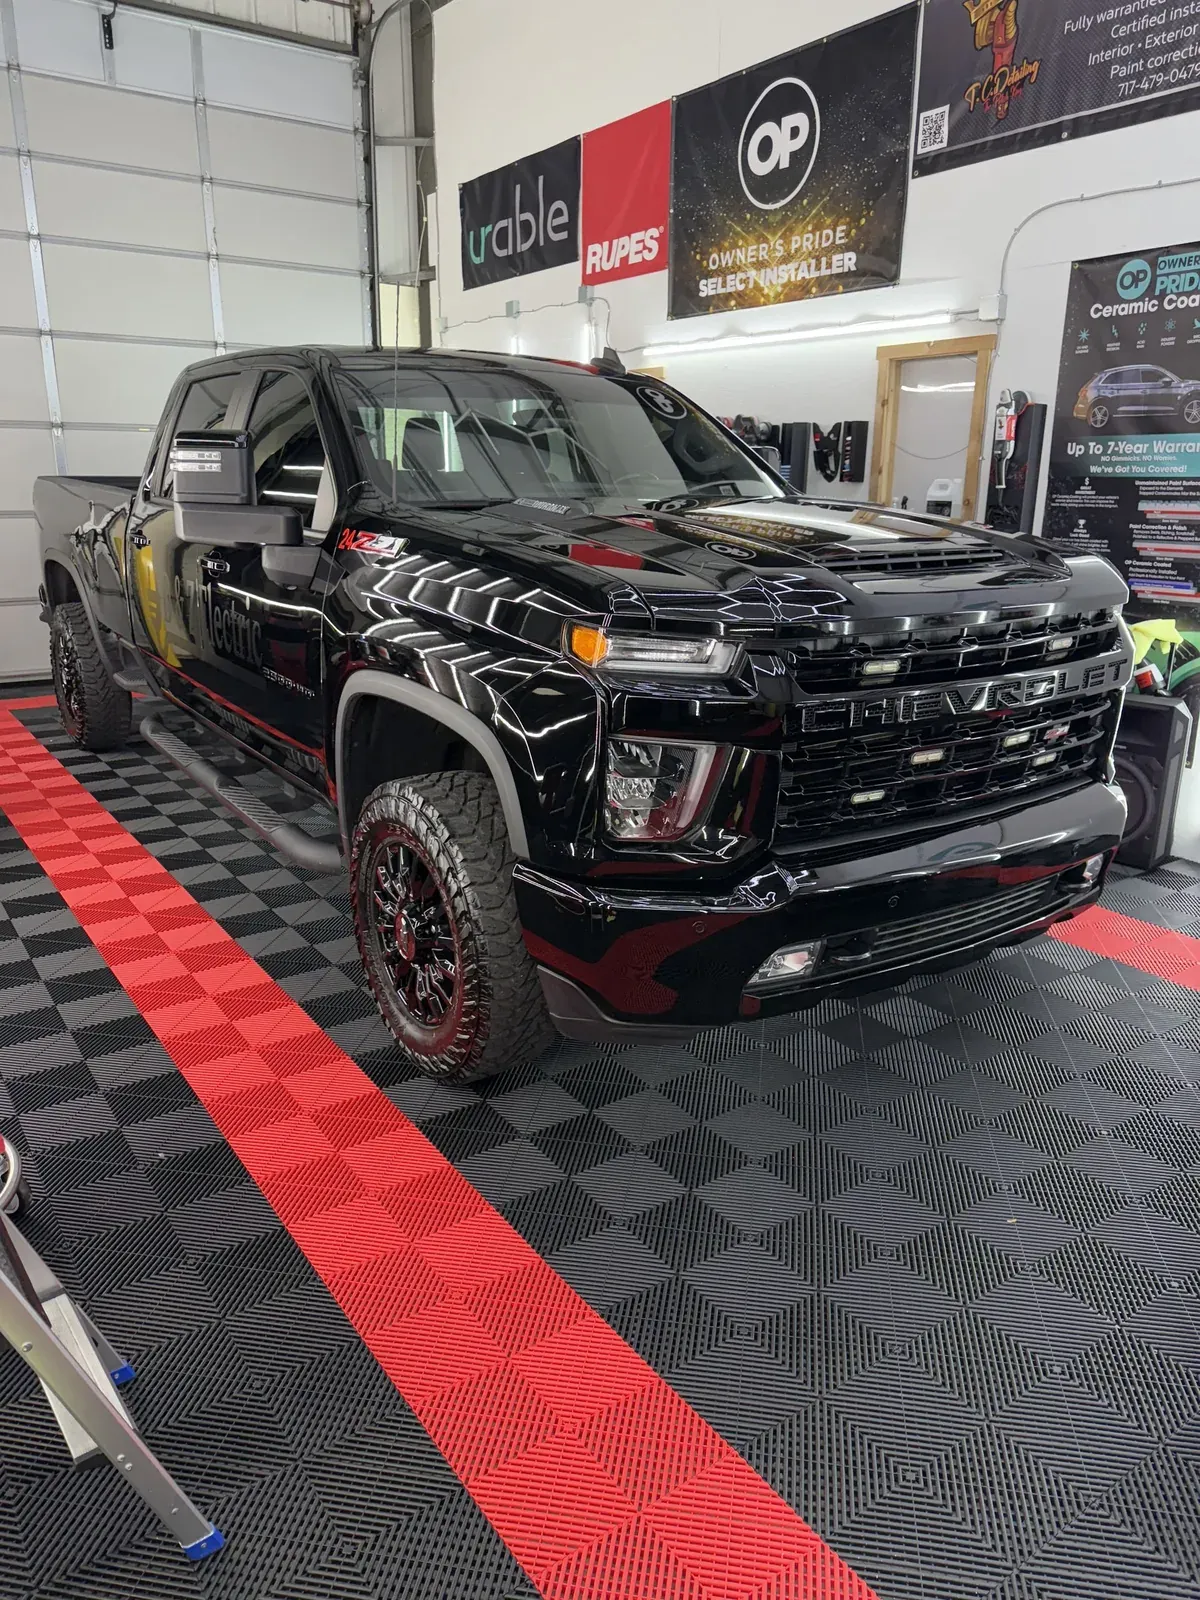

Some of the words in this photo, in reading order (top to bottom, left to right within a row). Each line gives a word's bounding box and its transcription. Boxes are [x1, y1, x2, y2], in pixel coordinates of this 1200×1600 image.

[1064, 15, 1094, 35] Fully
[1096, 0, 1166, 23] warrantie
[1111, 9, 1166, 38] Certified
[1088, 43, 1135, 66] Interior
[1145, 24, 1199, 49] Exterior
[1110, 58, 1144, 79] Paint
[1147, 42, 1200, 69] correcti
[1118, 62, 1200, 97] 717-479-0479
[747, 112, 809, 176] OP
[469, 175, 569, 265] urable
[585, 228, 661, 276] RUPES
[708, 237, 784, 271] OWNER'S
[791, 225, 847, 252] PRIDE
[699, 272, 754, 298] SELECT
[760, 251, 857, 285] INSTALLER
[1119, 268, 1148, 291] OP
[1090, 298, 1159, 319] Ceramic
[1067, 442, 1085, 457] Up
[1088, 441, 1103, 455] To
[1107, 441, 1149, 454] 7-Year
[1090, 465, 1113, 473] We've
[1115, 464, 1130, 473] Got
[1131, 465, 1146, 473] You
[1148, 465, 1187, 473] Covered!
[801, 658, 1128, 733] CHEVROLET
